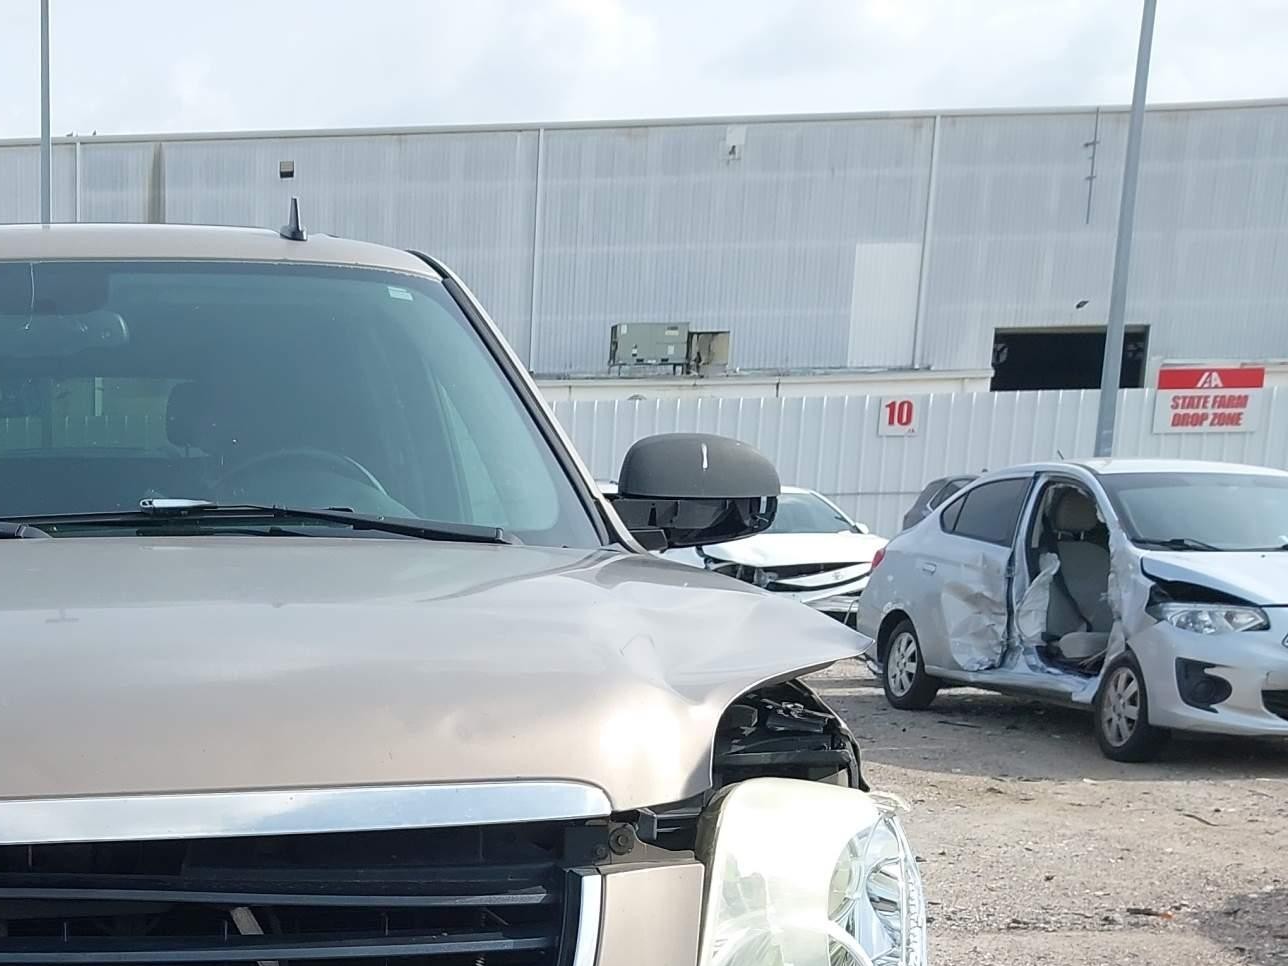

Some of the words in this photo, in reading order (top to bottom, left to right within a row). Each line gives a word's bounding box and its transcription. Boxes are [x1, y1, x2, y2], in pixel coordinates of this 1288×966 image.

[1171, 395, 1211, 409] STATE
[1211, 394, 1249, 408] FARM
[885, 400, 914, 426] 10
[1171, 412, 1209, 427] DROP
[1209, 412, 1244, 426] ZONE
